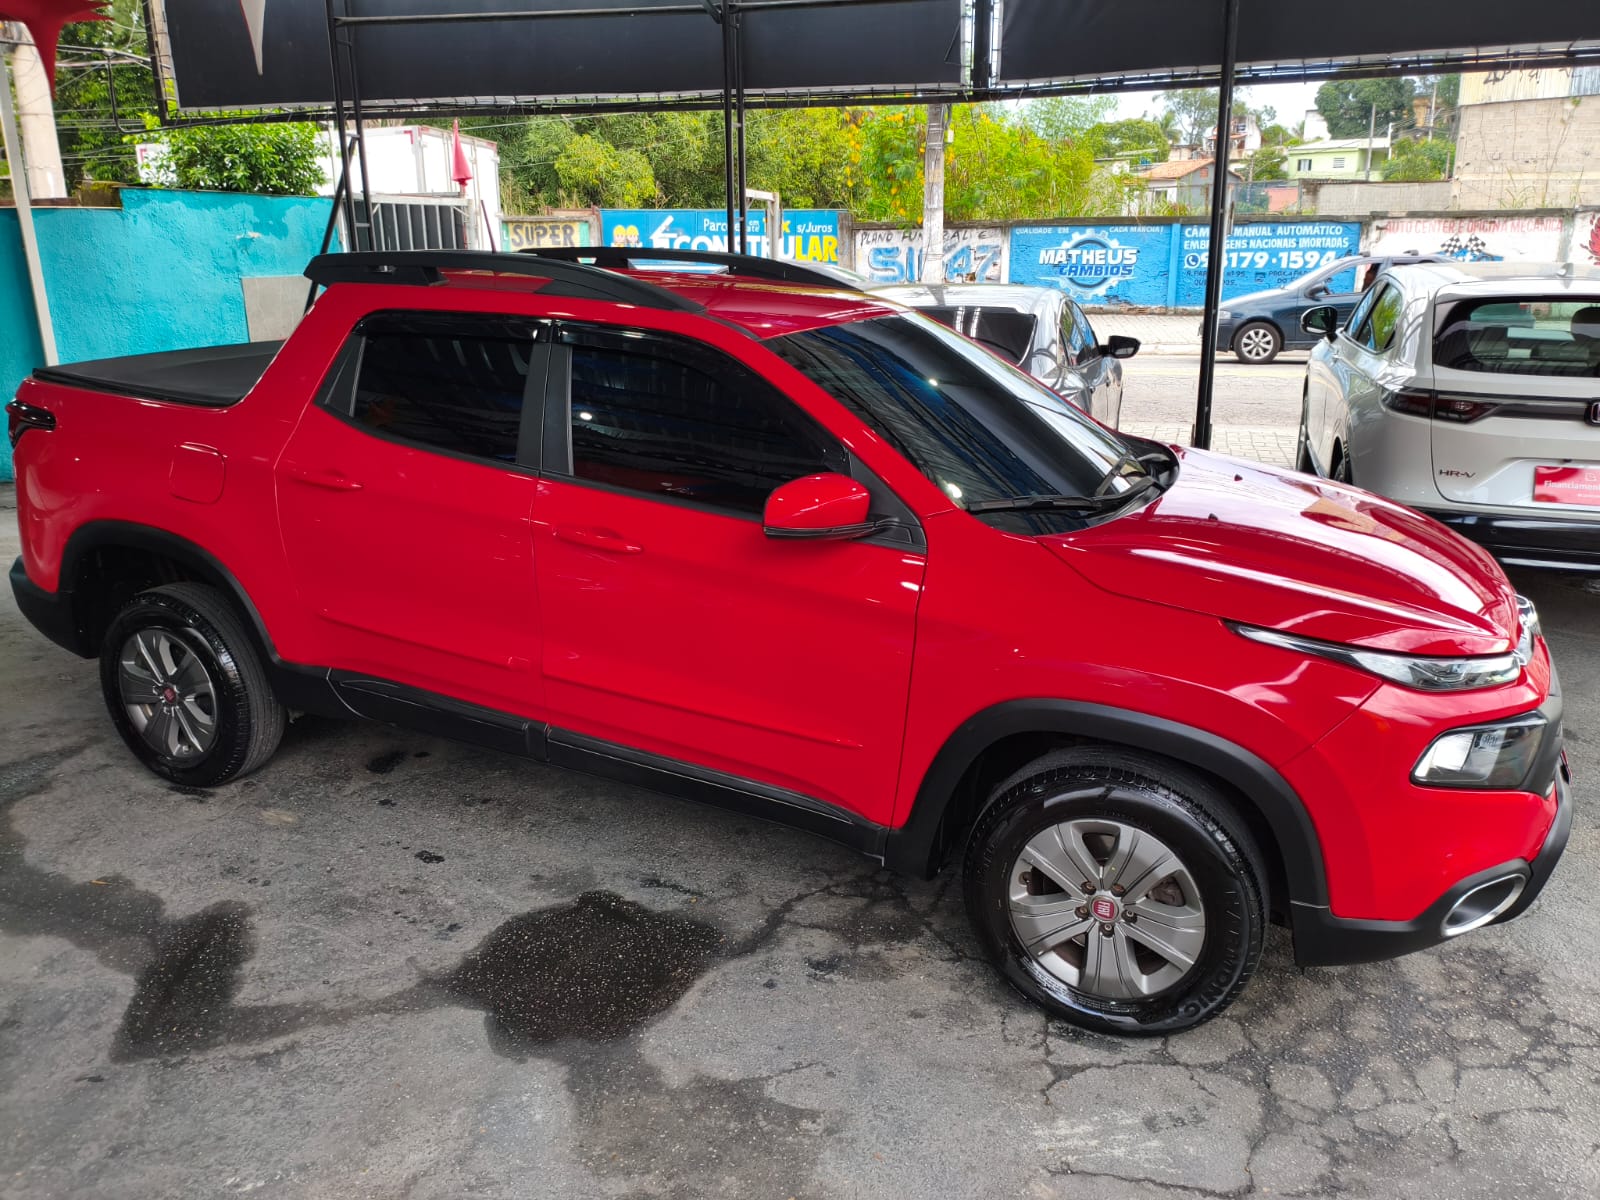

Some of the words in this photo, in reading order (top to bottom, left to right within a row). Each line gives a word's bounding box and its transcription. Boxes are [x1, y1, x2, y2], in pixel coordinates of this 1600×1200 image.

[797, 221, 833, 234] s/Juros
[1233, 226, 1272, 238] MANUAL
[1277, 223, 1343, 237] AUTOMÁTICO
[1386, 220, 1413, 234] AUTO
[1414, 219, 1456, 234] CENTER
[511, 223, 576, 248] SUPER
[860, 230, 893, 247] PLANO
[1249, 237, 1297, 249] NACIONAIS
[1038, 249, 1138, 265] MATHEUS
[1058, 264, 1134, 278] CAMBIOS
[1439, 469, 1477, 478] HR-V
